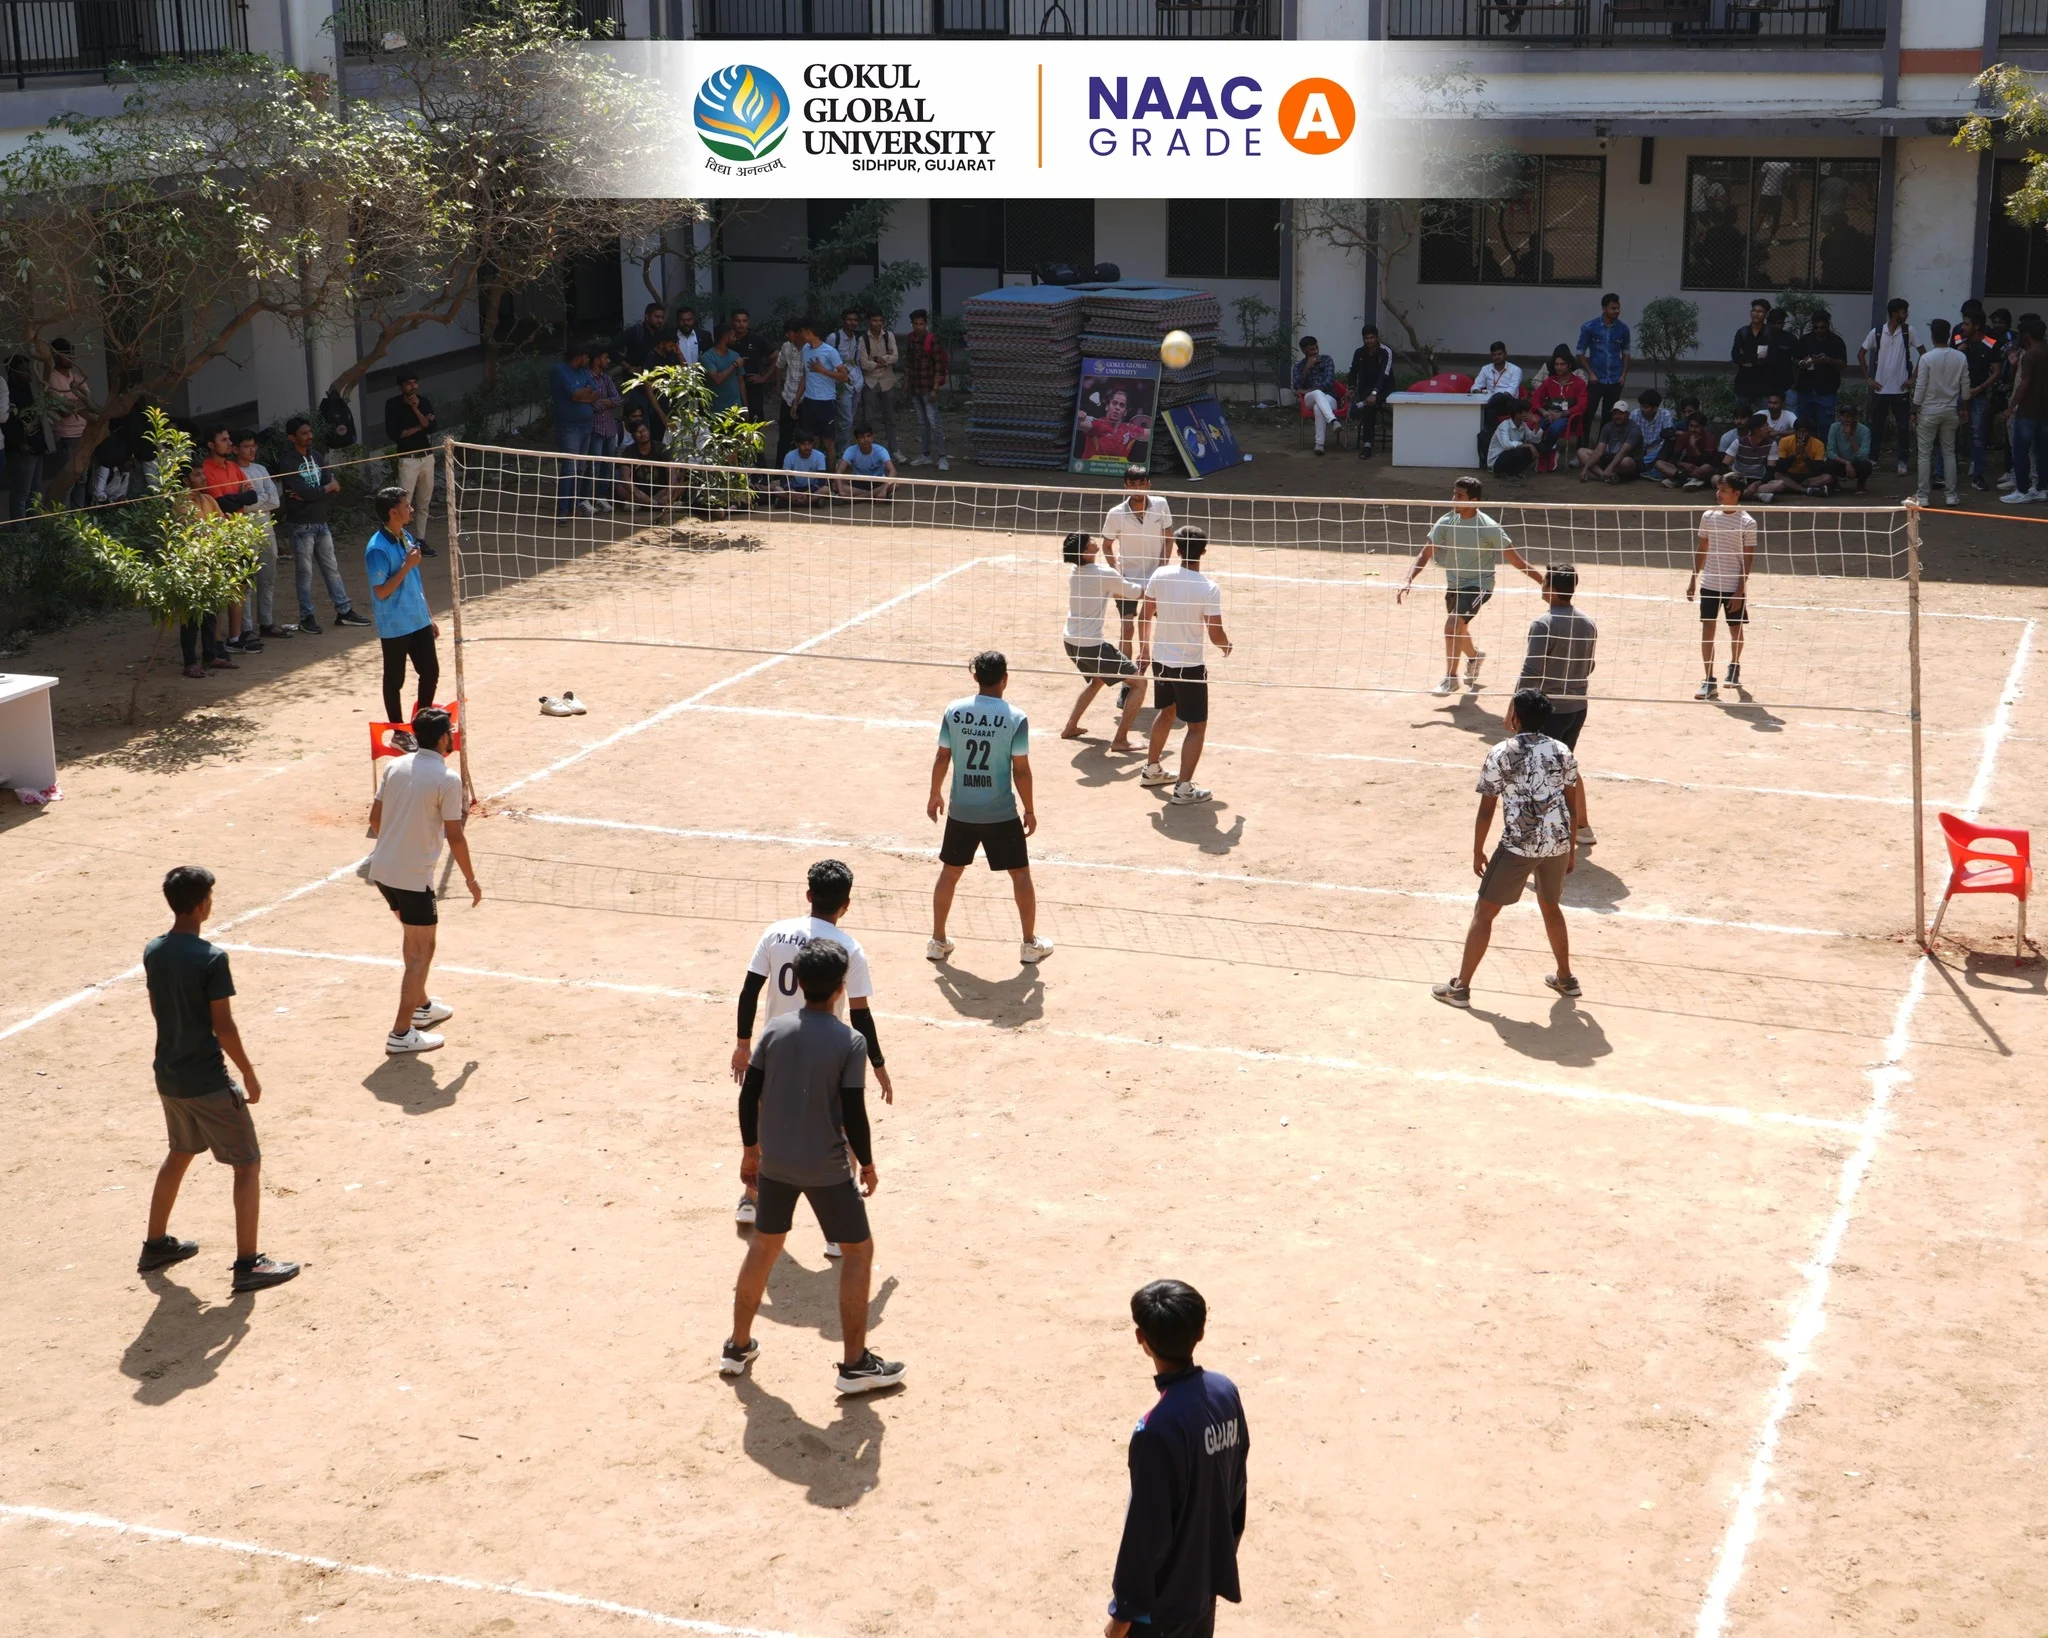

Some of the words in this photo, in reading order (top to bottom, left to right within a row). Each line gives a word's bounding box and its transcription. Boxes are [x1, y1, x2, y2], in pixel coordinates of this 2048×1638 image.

[953, 711, 1007, 729] S.D.A.U.
[961, 728, 996, 738] GUJARAT
[966, 739, 991, 771] 22
[963, 774, 992, 788] DAMOR
[776, 933, 807, 947] M.HA
[778, 962, 799, 997] 0
